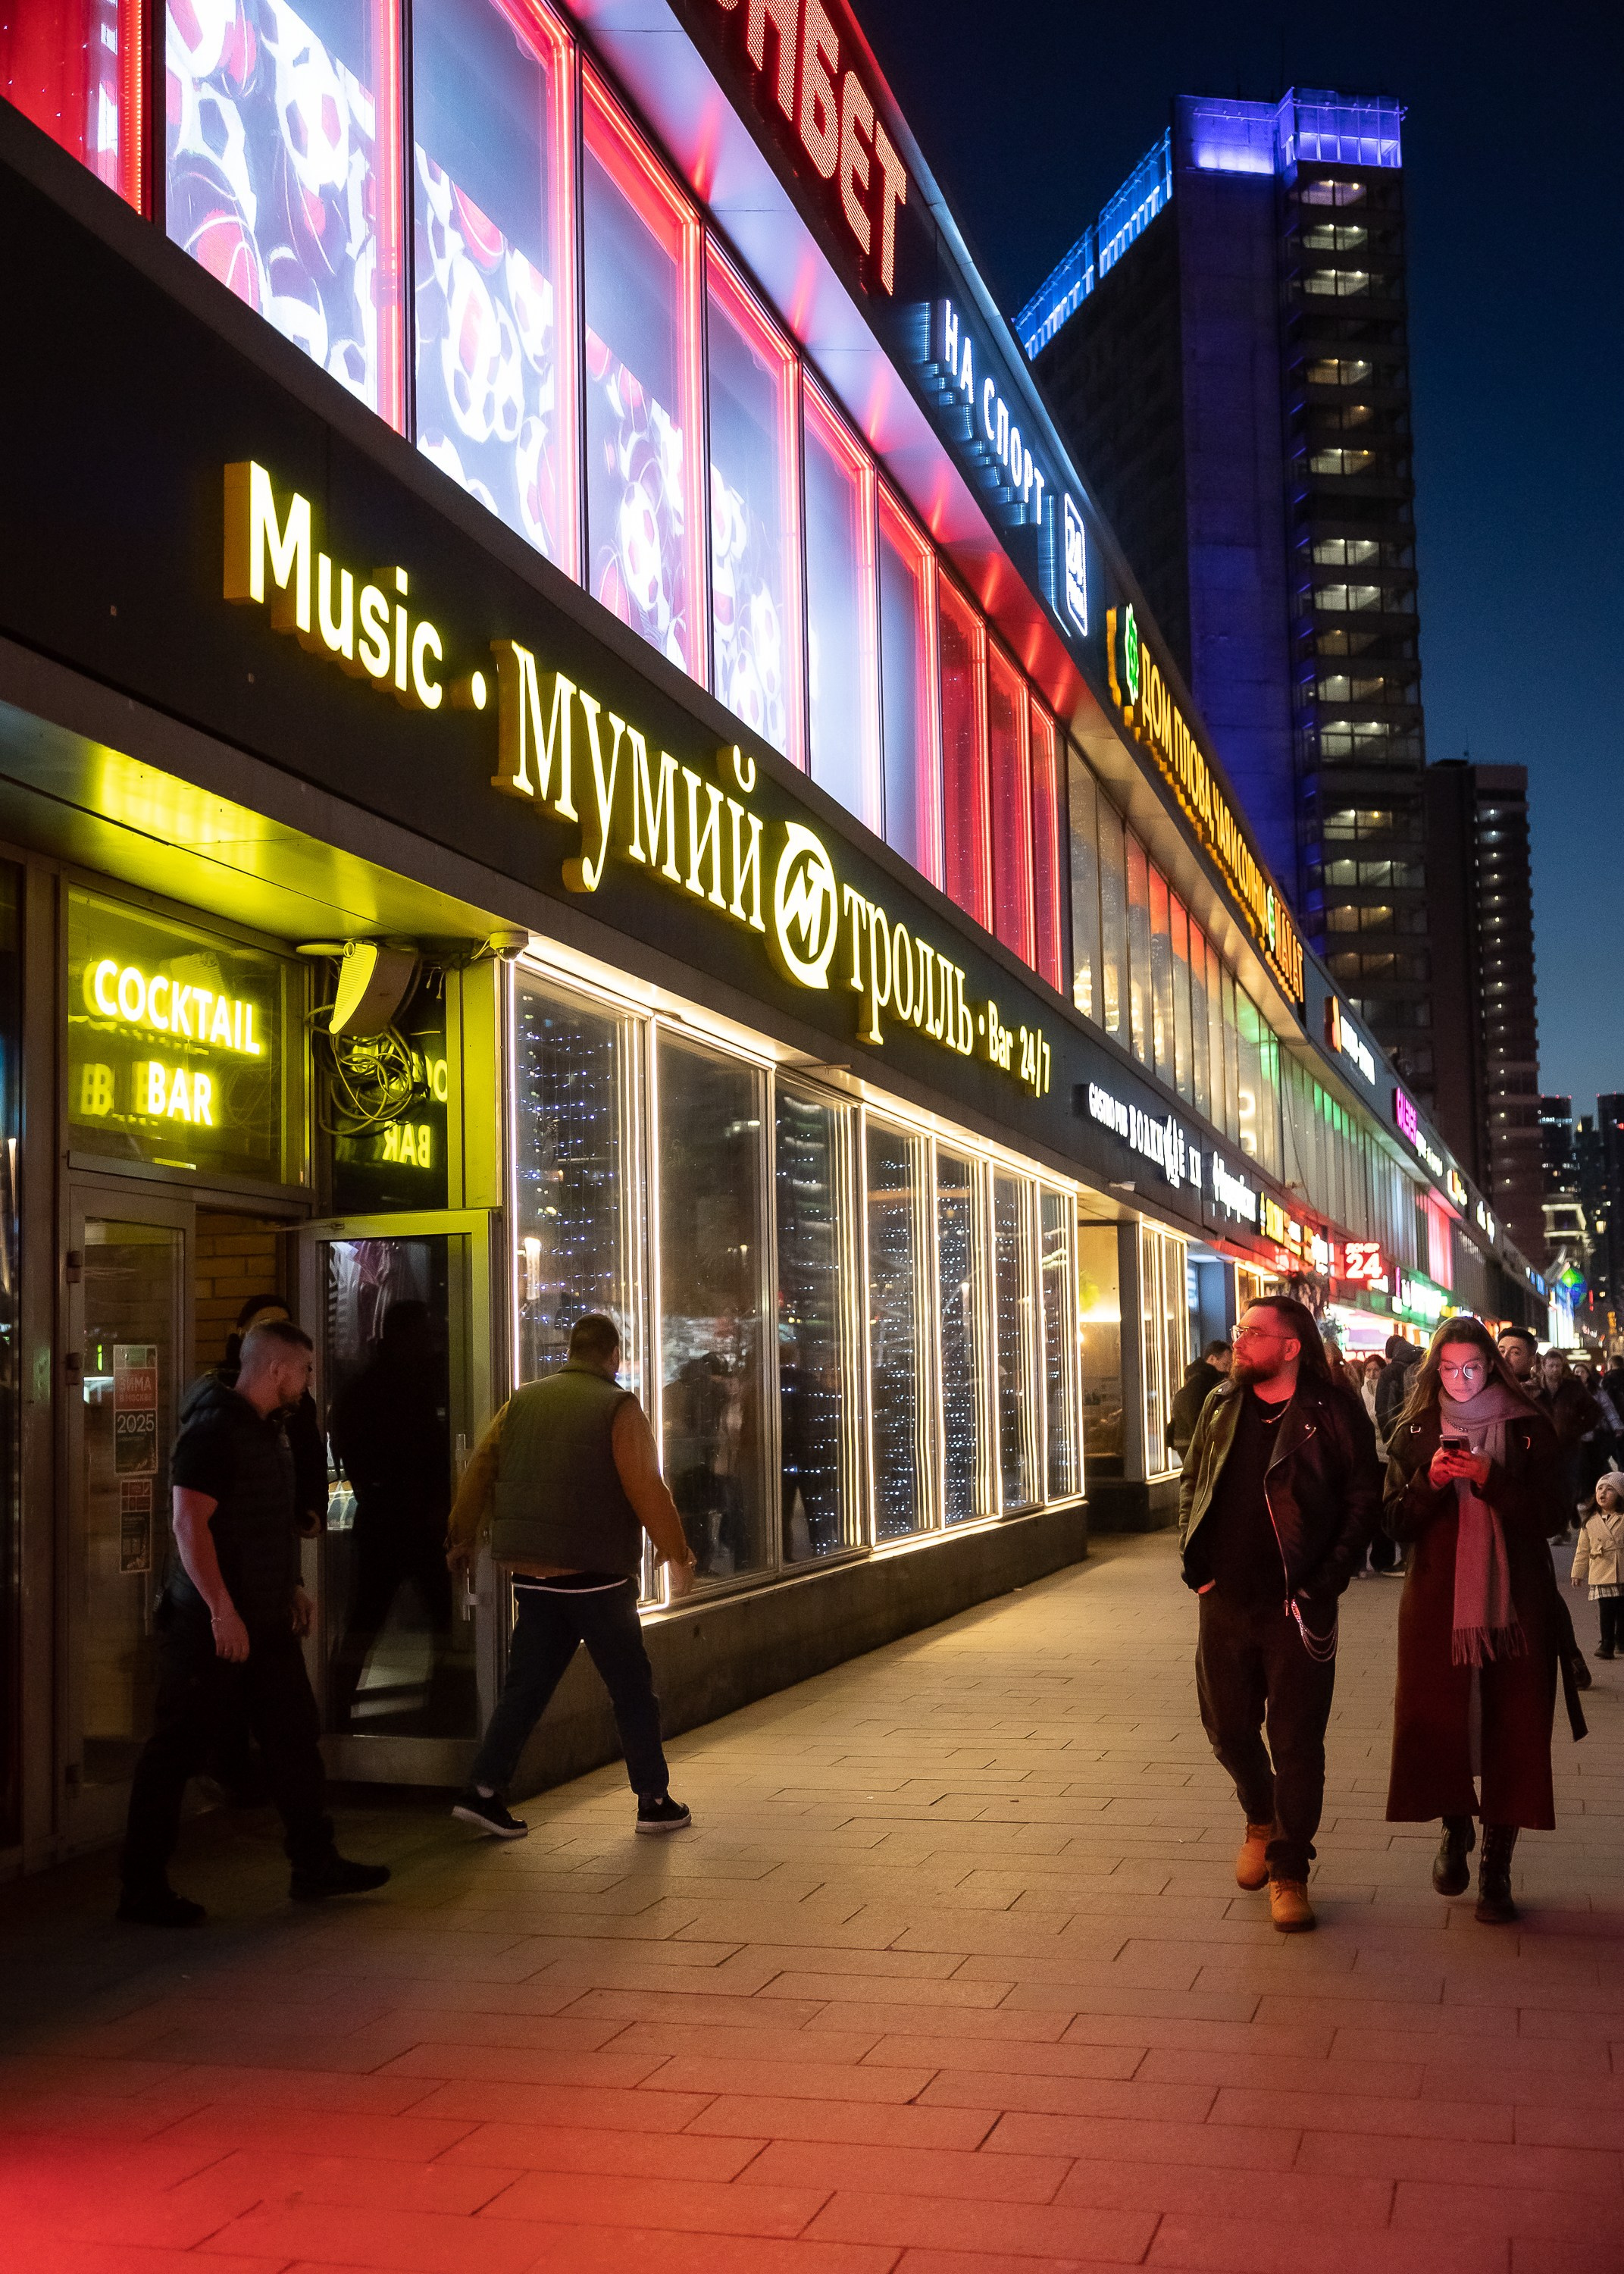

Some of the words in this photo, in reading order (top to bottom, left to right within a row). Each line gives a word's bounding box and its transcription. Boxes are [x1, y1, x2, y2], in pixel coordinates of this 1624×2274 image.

[719, 0, 906, 296] БЕТ
[945, 299, 974, 404] НА
[984, 377, 1044, 525] СПОРТ
[249, 461, 443, 711] Music
[1141, 642, 1172, 762] ДОМ
[1174, 706, 1214, 843] ПЛОВА,
[1213, 781, 1231, 866] ЧАЯ
[1230, 816, 1238, 879] И
[95, 959, 261, 1055] COCKTAIL
[988, 999, 1013, 1071] Bar
[1019, 1025, 1050, 1098] 24/7
[149, 1060, 214, 1126] BAR
[1346, 1253, 1383, 1279] 24
[117, 1414, 155, 1434] 2025
